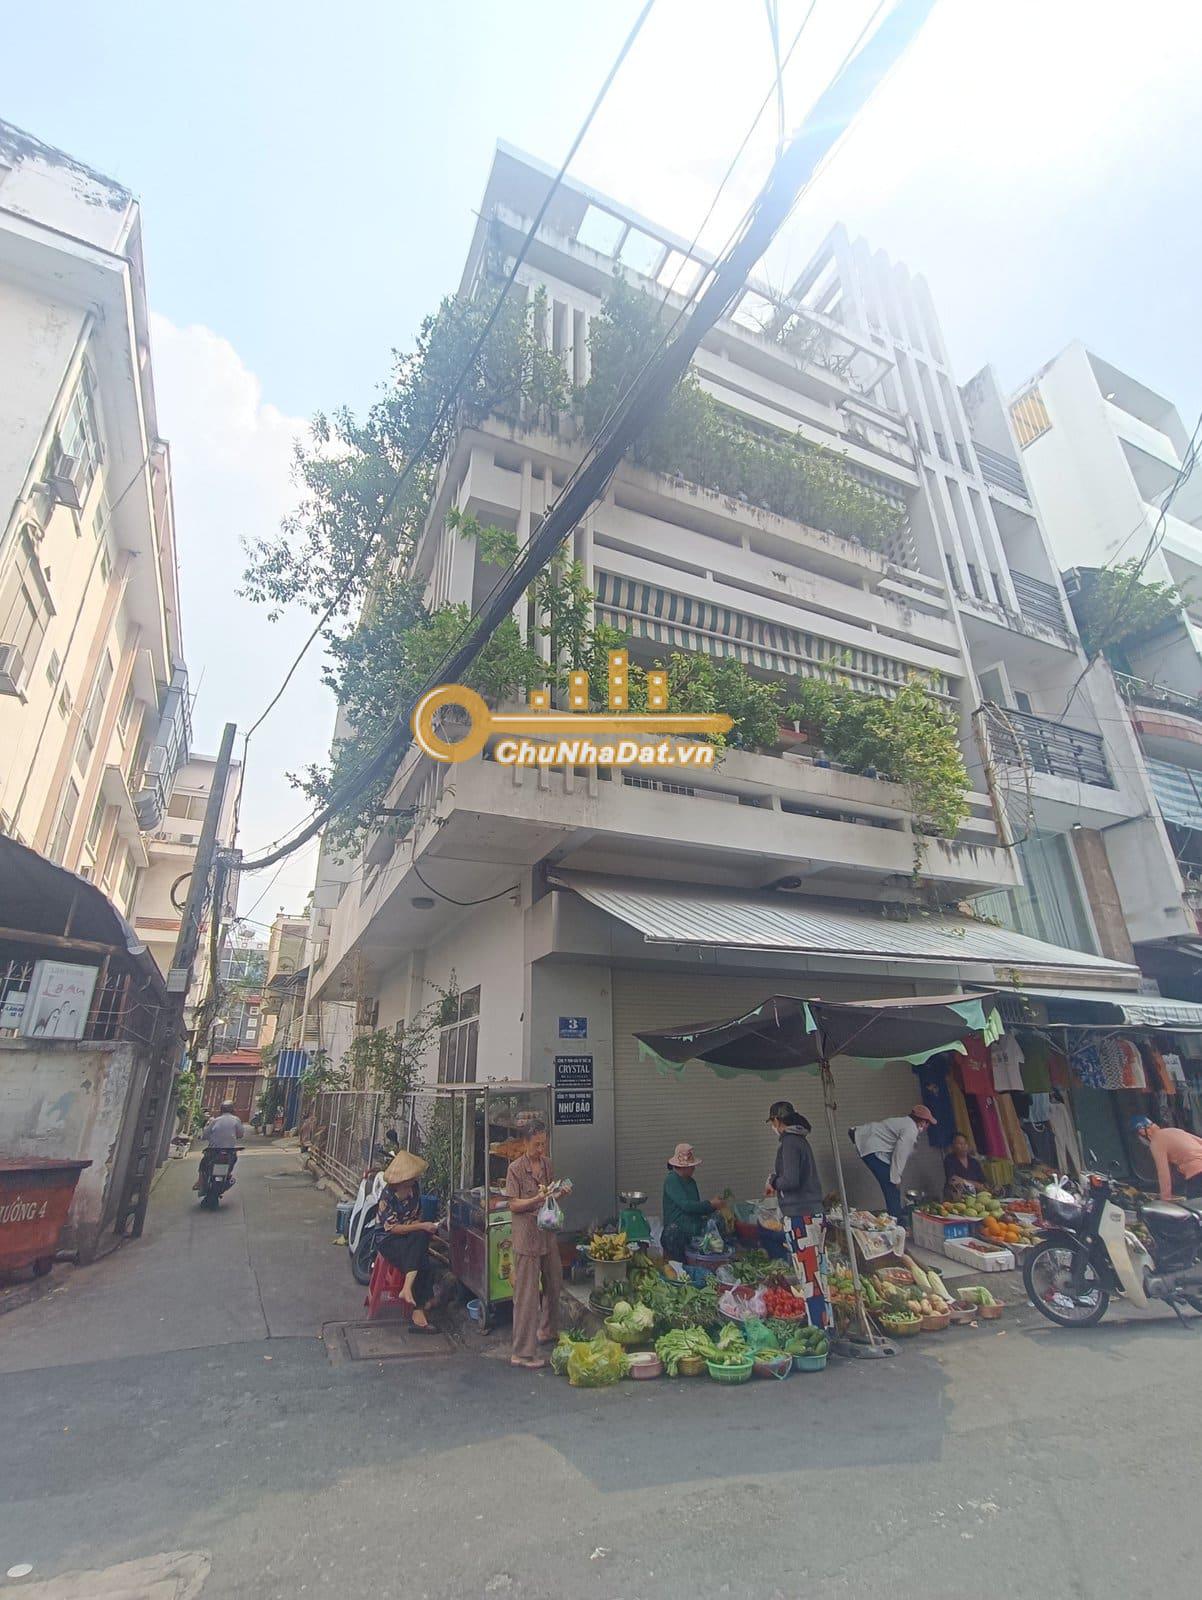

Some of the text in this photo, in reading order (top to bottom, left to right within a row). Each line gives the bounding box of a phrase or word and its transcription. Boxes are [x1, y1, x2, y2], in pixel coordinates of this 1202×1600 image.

[568, 1018, 578, 1029] 3
[558, 1064, 590, 1074] CRYSTAL
[558, 1099, 590, 1113] NHƯ BẢO
[38, 1200, 48, 1218] 4
